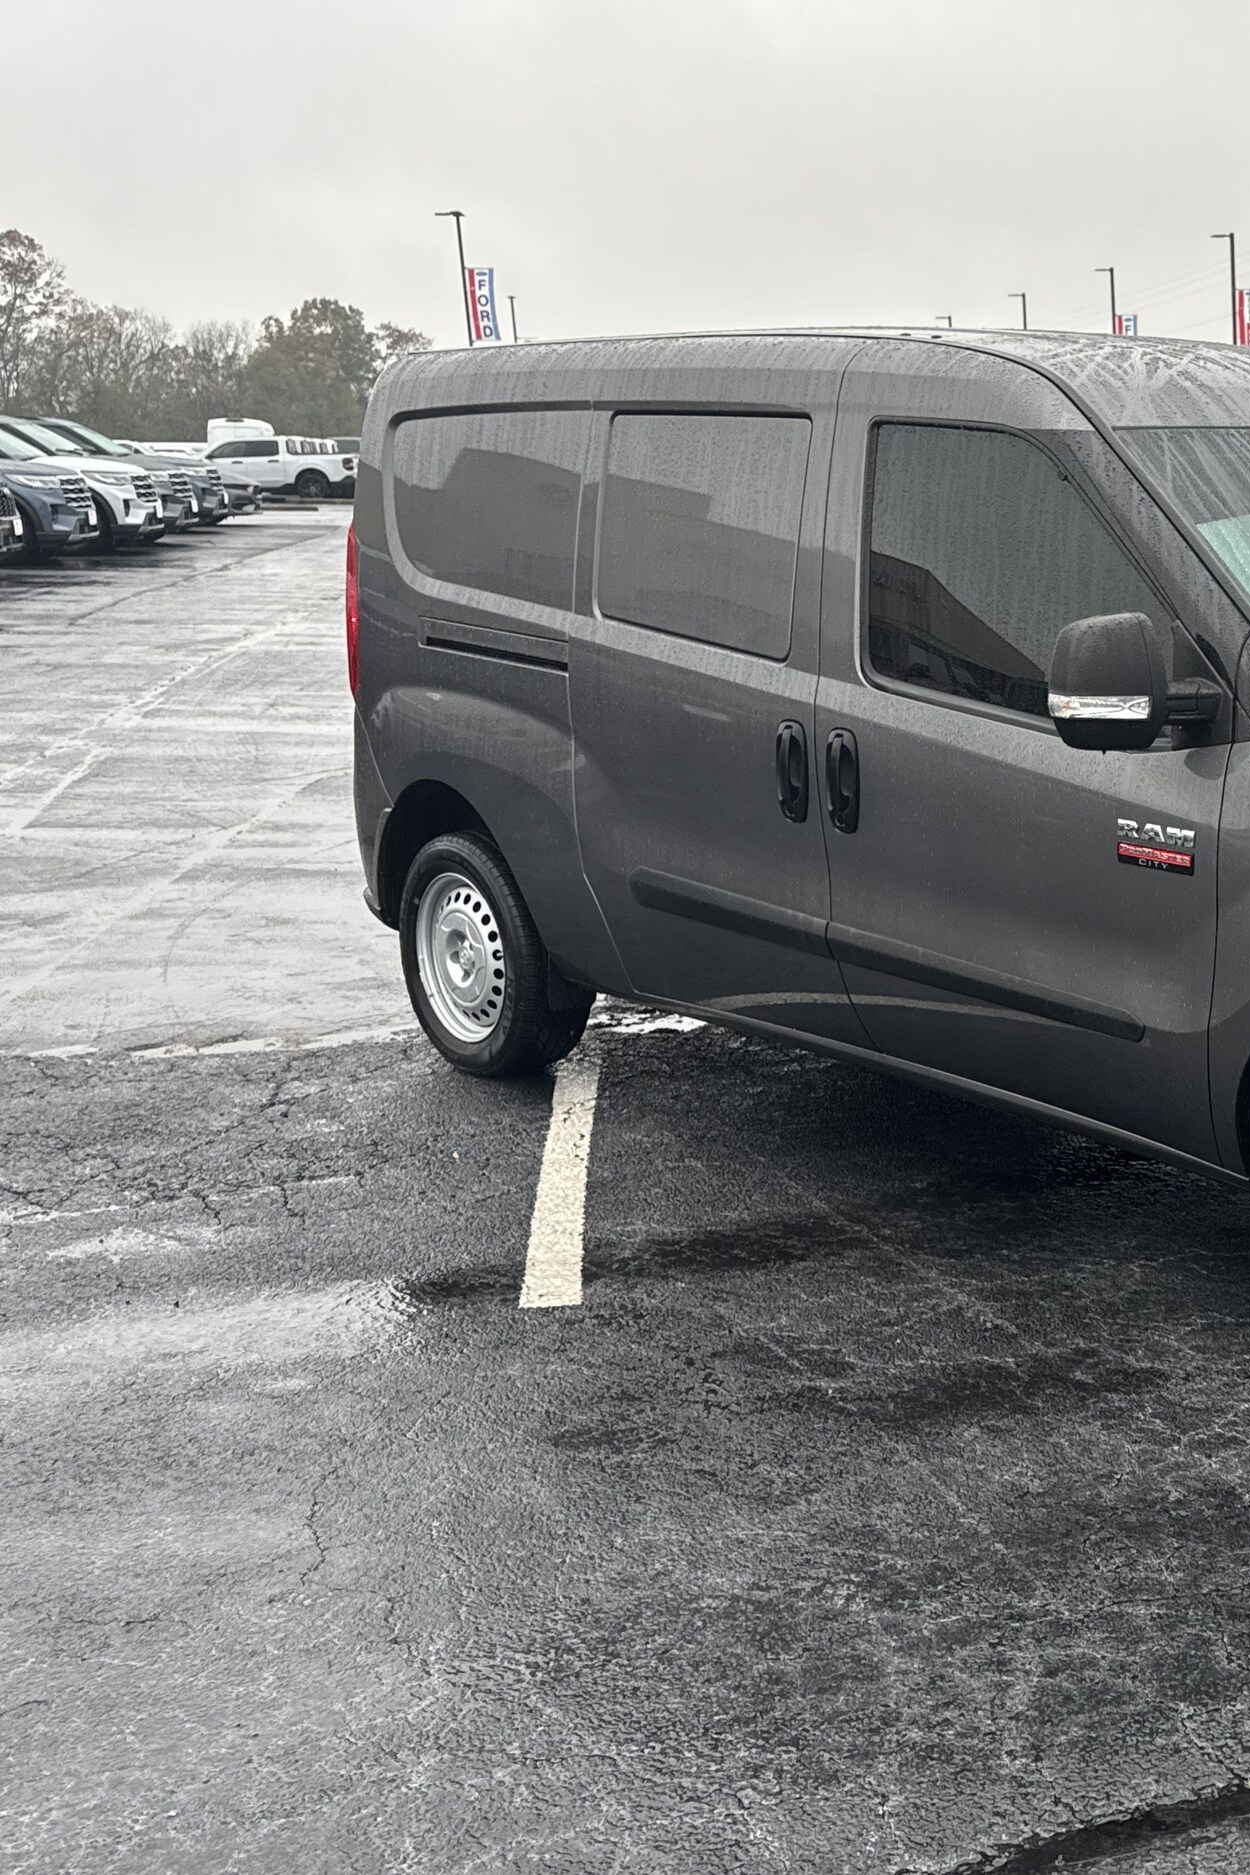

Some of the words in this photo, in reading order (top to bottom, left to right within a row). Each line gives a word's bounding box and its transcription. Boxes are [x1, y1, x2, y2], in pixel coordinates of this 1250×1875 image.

[477, 279, 494, 338] FORD
[1117, 818, 1196, 848] RAM
[1138, 858, 1169, 869] CITY
